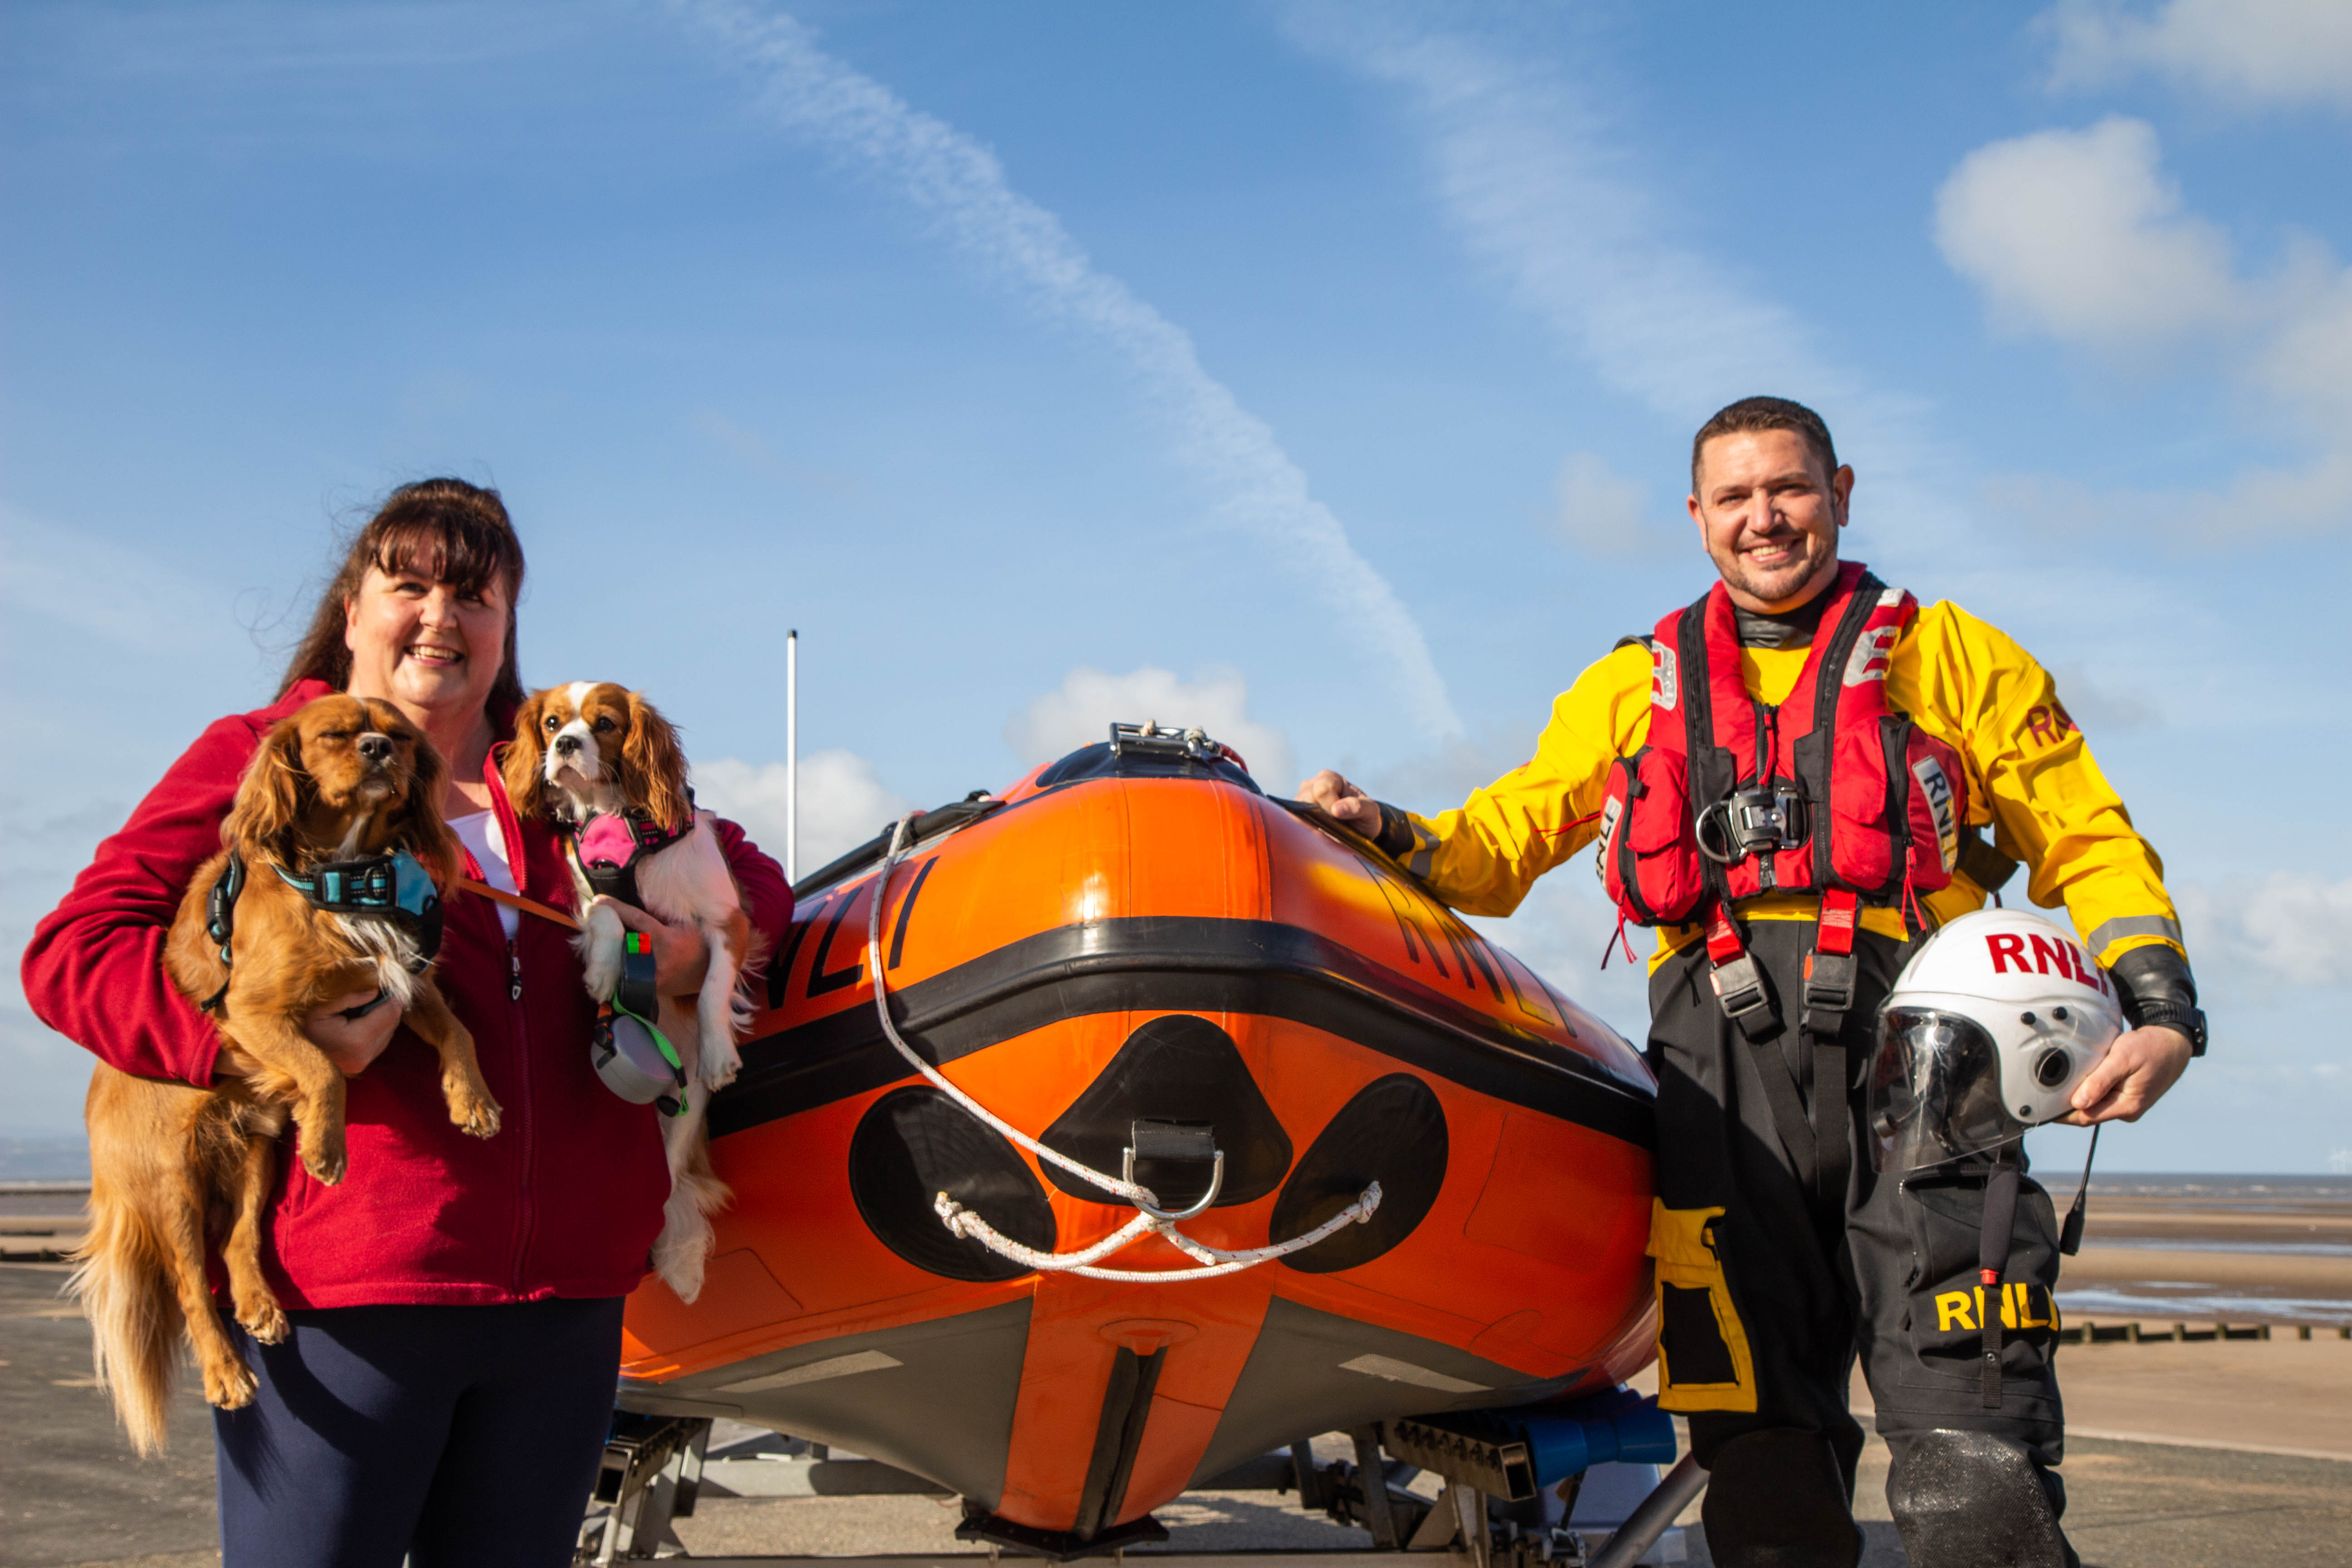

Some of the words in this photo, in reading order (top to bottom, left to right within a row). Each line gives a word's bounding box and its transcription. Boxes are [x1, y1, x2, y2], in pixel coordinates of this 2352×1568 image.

[767, 855, 940, 1011] NLI
[1353, 854, 1577, 1038] RNLI
[1984, 933, 2109, 998] RNLI
